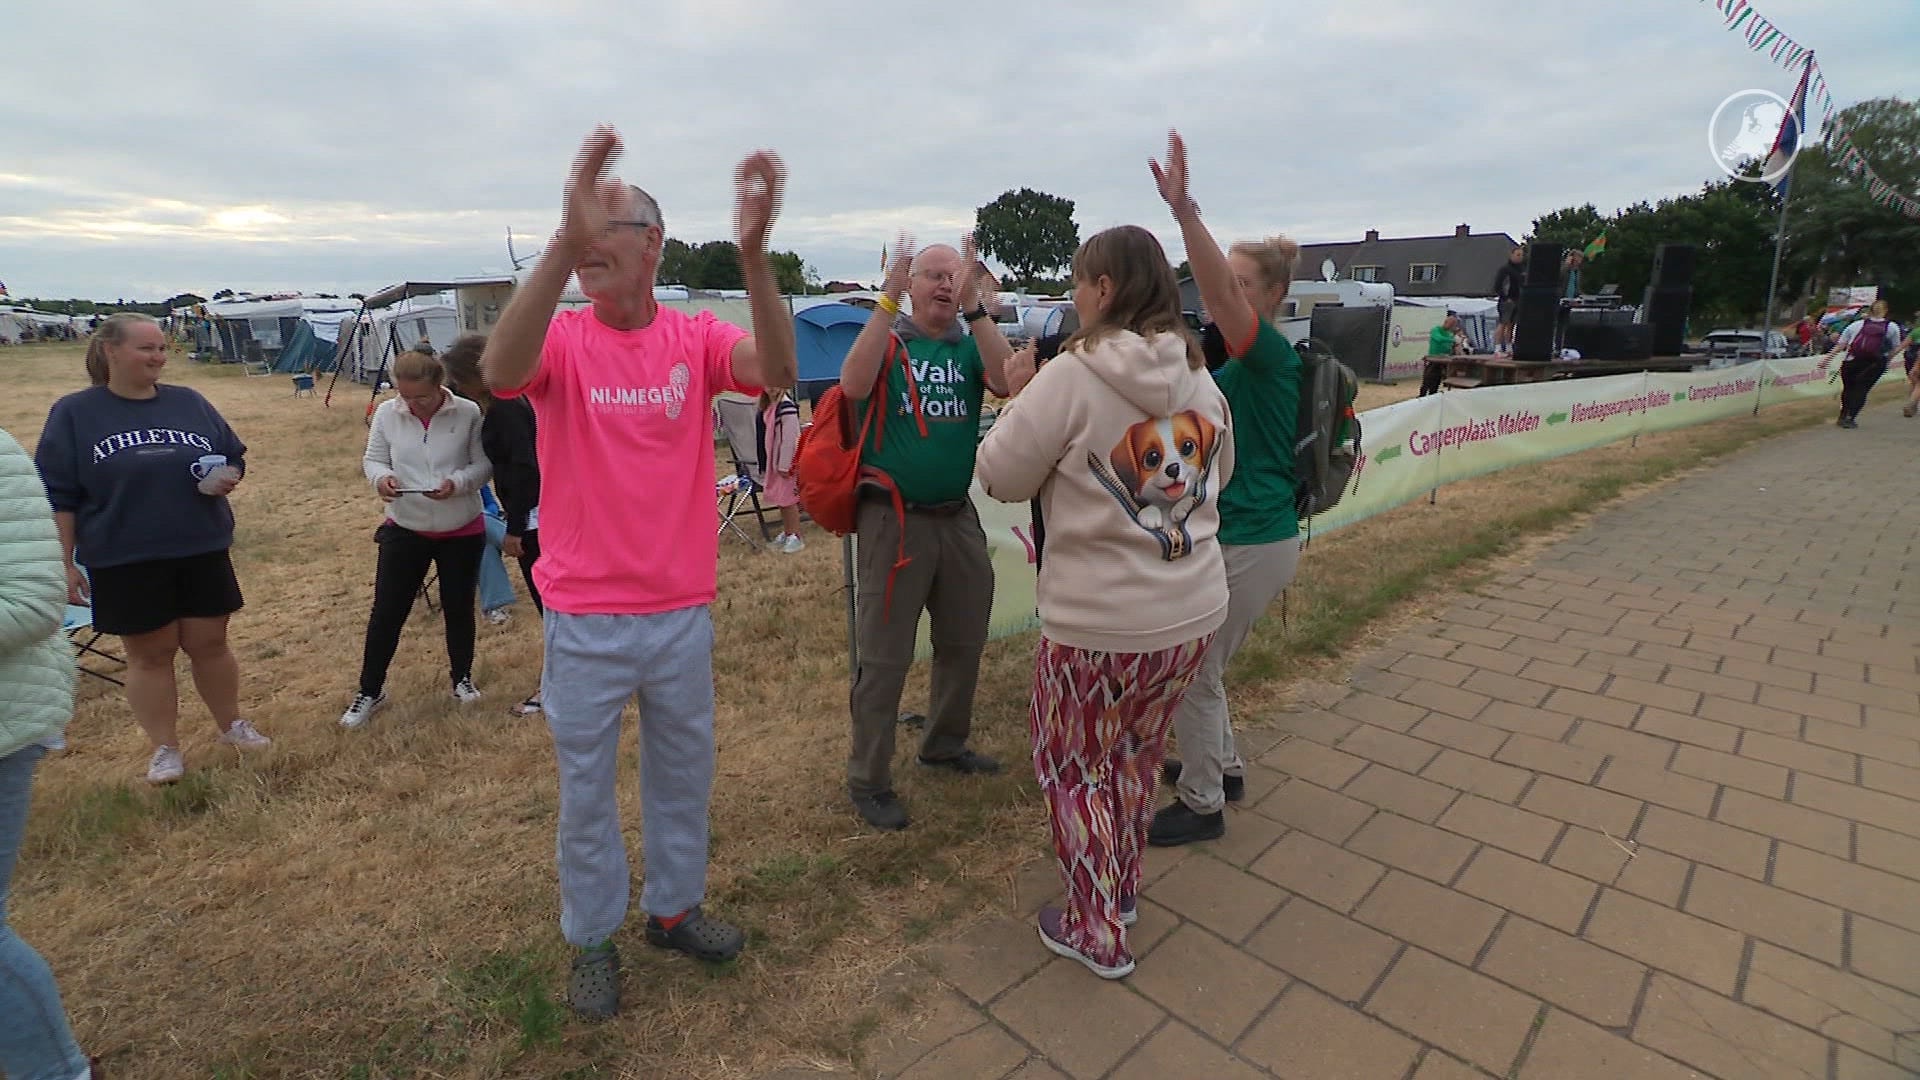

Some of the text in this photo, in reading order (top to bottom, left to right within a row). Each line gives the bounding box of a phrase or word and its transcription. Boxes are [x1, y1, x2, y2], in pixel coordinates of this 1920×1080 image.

[902, 359, 965, 383] Walk
[591, 385, 686, 406] NIJMEGEN
[920, 385, 954, 394] of the
[902, 393, 968, 417] World
[1498, 410, 1541, 436] Malden
[93, 428, 213, 464] ATHLETICS
